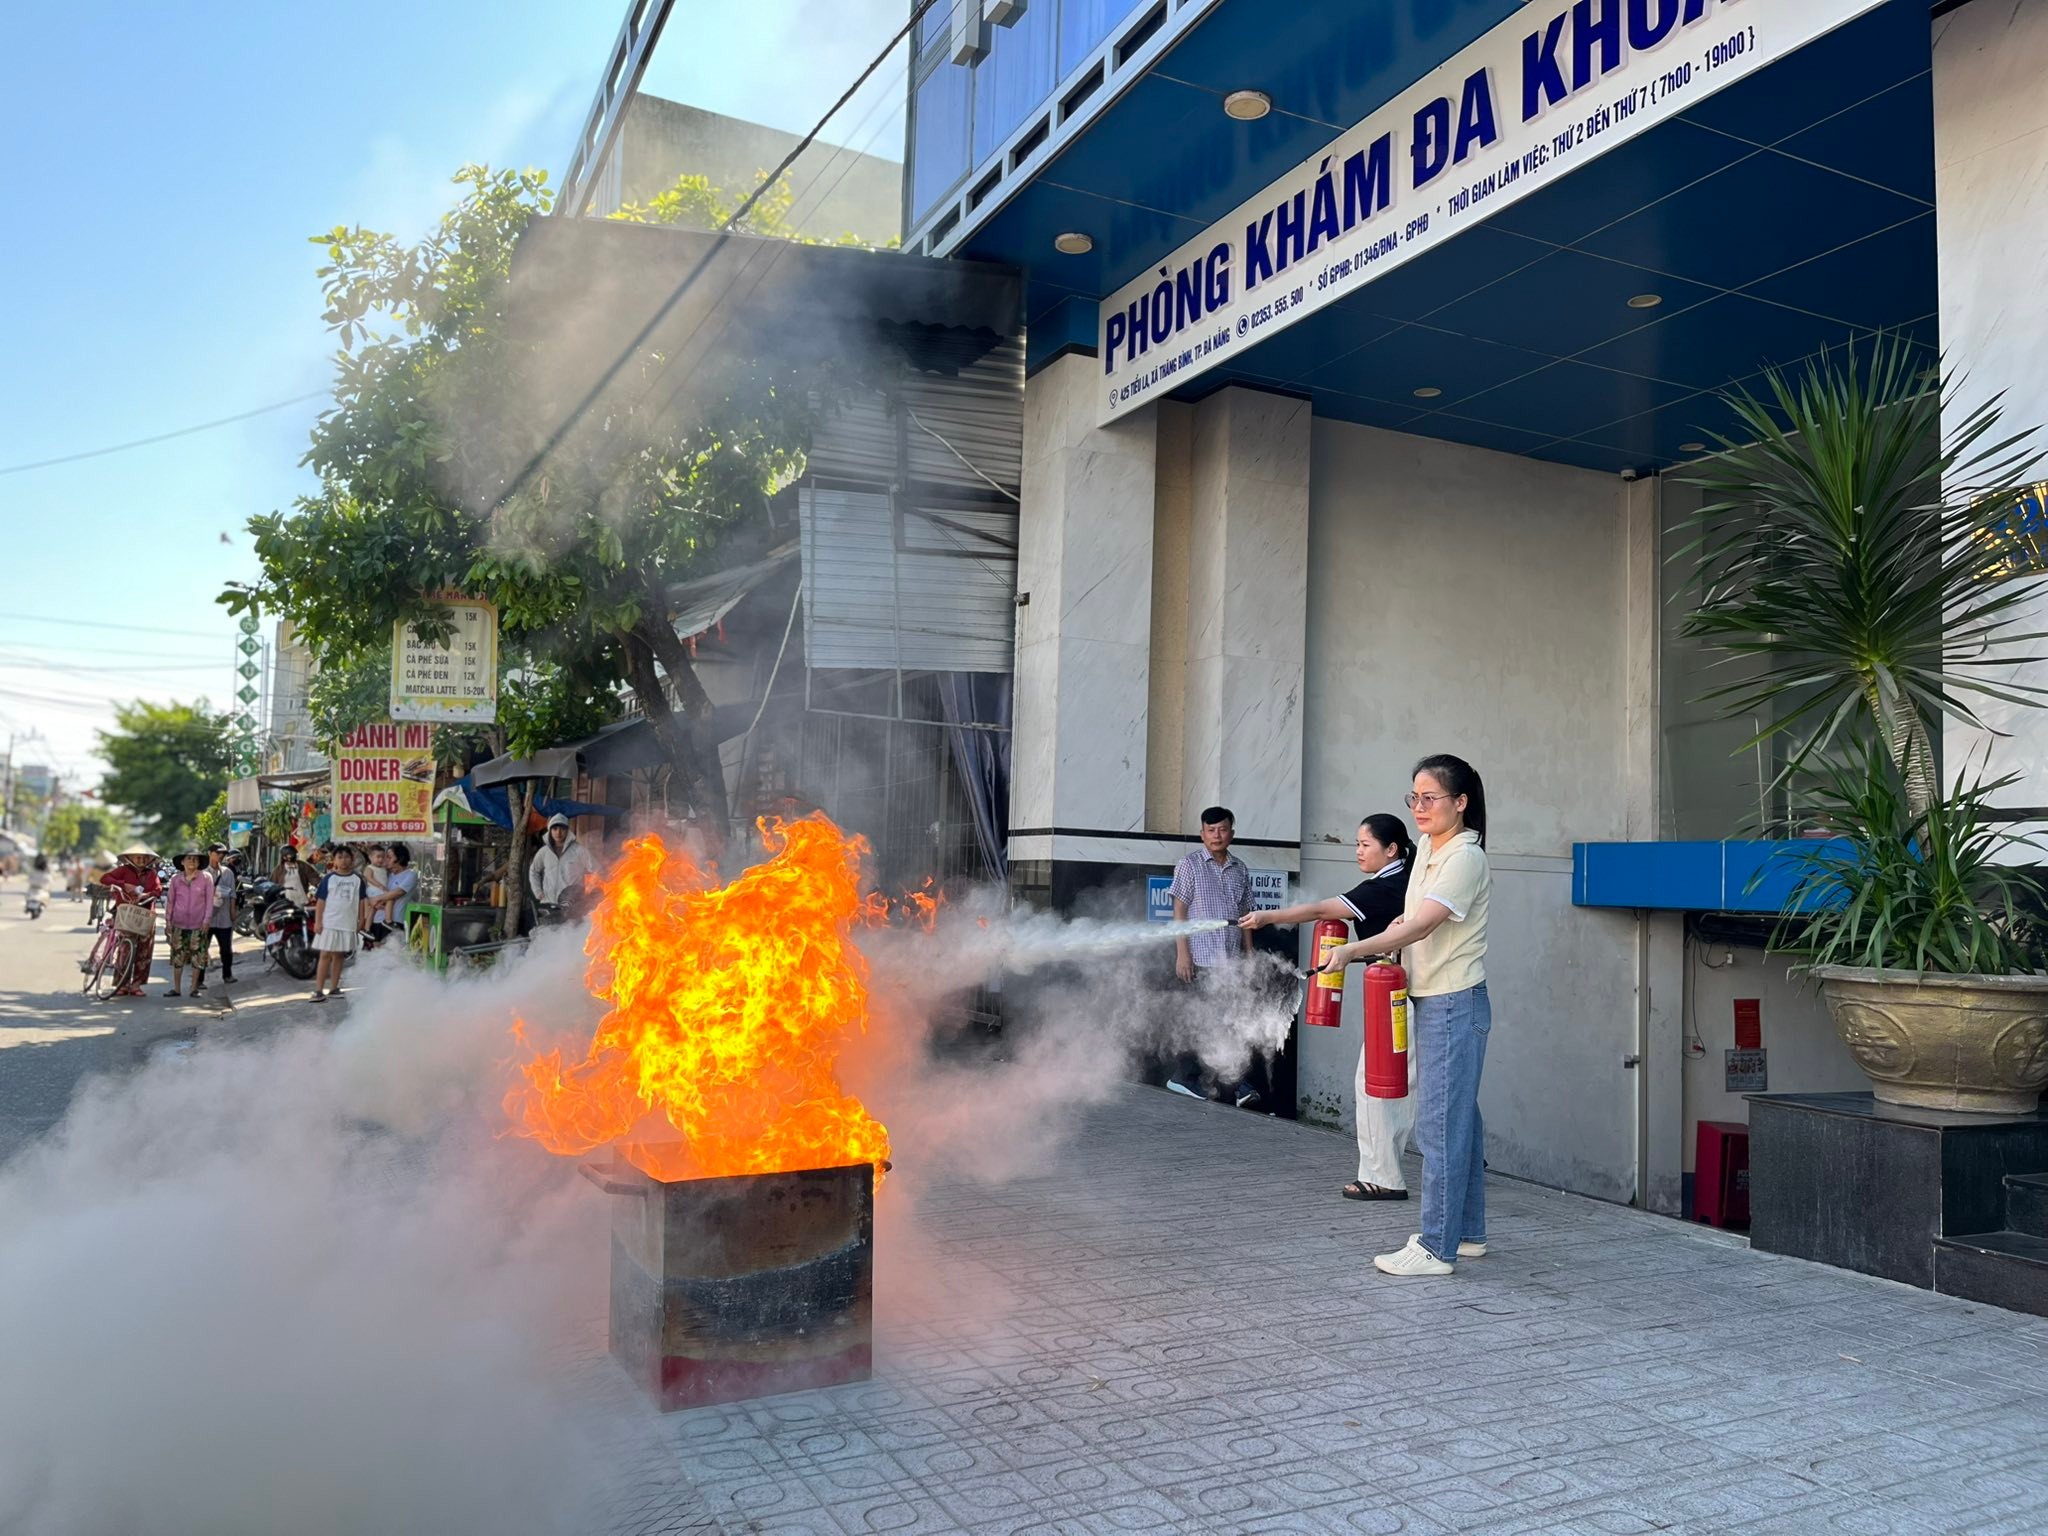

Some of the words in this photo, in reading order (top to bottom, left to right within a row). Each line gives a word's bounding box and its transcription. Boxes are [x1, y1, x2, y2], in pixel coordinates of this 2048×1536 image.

[1290, 286, 1303, 307] 500
[1318, 264, 1329, 291] SỐ
[1448, 186, 1470, 217] THỜI
[1471, 173, 1496, 204] GIAN
[1498, 158, 1520, 189] LÀM
[1523, 144, 1549, 175] VIỆC:
[1552, 123, 1575, 158] THỨ
[1576, 122, 1584, 145] 2
[1586, 104, 1610, 139] ĐẾN
[1613, 88, 1638, 123] THỨ
[1640, 86, 1647, 109] 7
[1660, 61, 1691, 98] 7h00
[1704, 31, 1745, 73] 19h00
[1105, 242, 1231, 376] PHÒNG
[1246, 131, 1392, 291] KHÁM
[1410, 66, 1498, 190] ĐA
[1522, 0, 1733, 123] KHO
[465, 612, 477, 621] 15K
[465, 642, 477, 651] 15K
[464, 656, 476, 665] 15K
[464, 671, 475, 680] 12K
[405, 684, 434, 694] MATCHA
[437, 685, 456, 695] LATTE
[340, 758, 401, 781] DONER
[341, 792, 399, 815] KEBAB
[361, 822, 378, 830] 037
[381, 822, 398, 830] 385
[401, 822, 425, 830] 6697
[1271, 876, 1282, 888] XE
